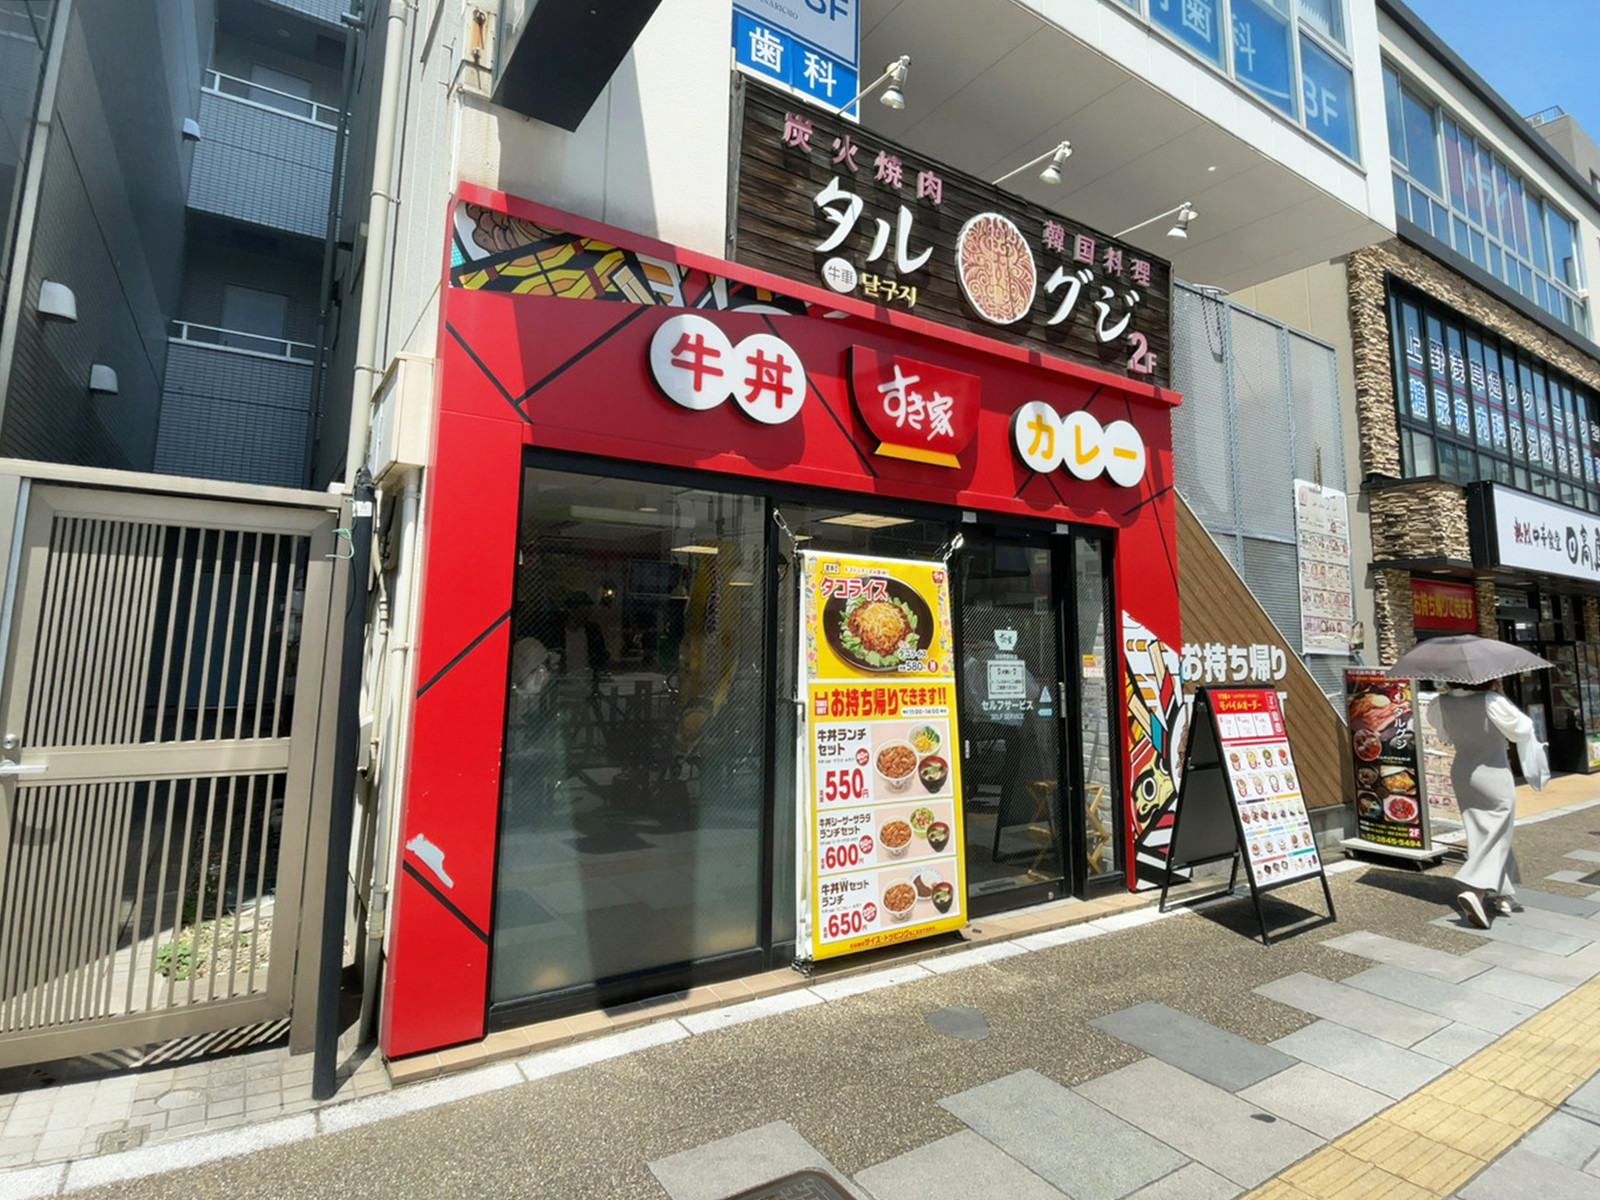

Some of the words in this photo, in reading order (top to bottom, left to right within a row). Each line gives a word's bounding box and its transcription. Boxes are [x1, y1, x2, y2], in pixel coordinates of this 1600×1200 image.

[749, 27, 837, 98] 歯科
[1301, 73, 1338, 127] 3F
[783, 111, 943, 205] 炭火焼肉
[1042, 220, 1150, 287] 韓国料理
[861, 272, 917, 308] 달구지
[671, 332, 793, 409] 牛丼
[1127, 332, 1157, 374] 2F
[877, 365, 954, 441] すき家
[1027, 414, 1138, 464] カレー
[821, 577, 888, 600] タコライス
[1181, 642, 1287, 682] お持ち帰り
[982, 700, 1034, 711] セルフサービス
[818, 728, 867, 742] 牛丼ランチ
[818, 743, 845, 756] セット
[820, 826, 860, 839] ランチセット
[822, 894, 844, 907] ランチ
